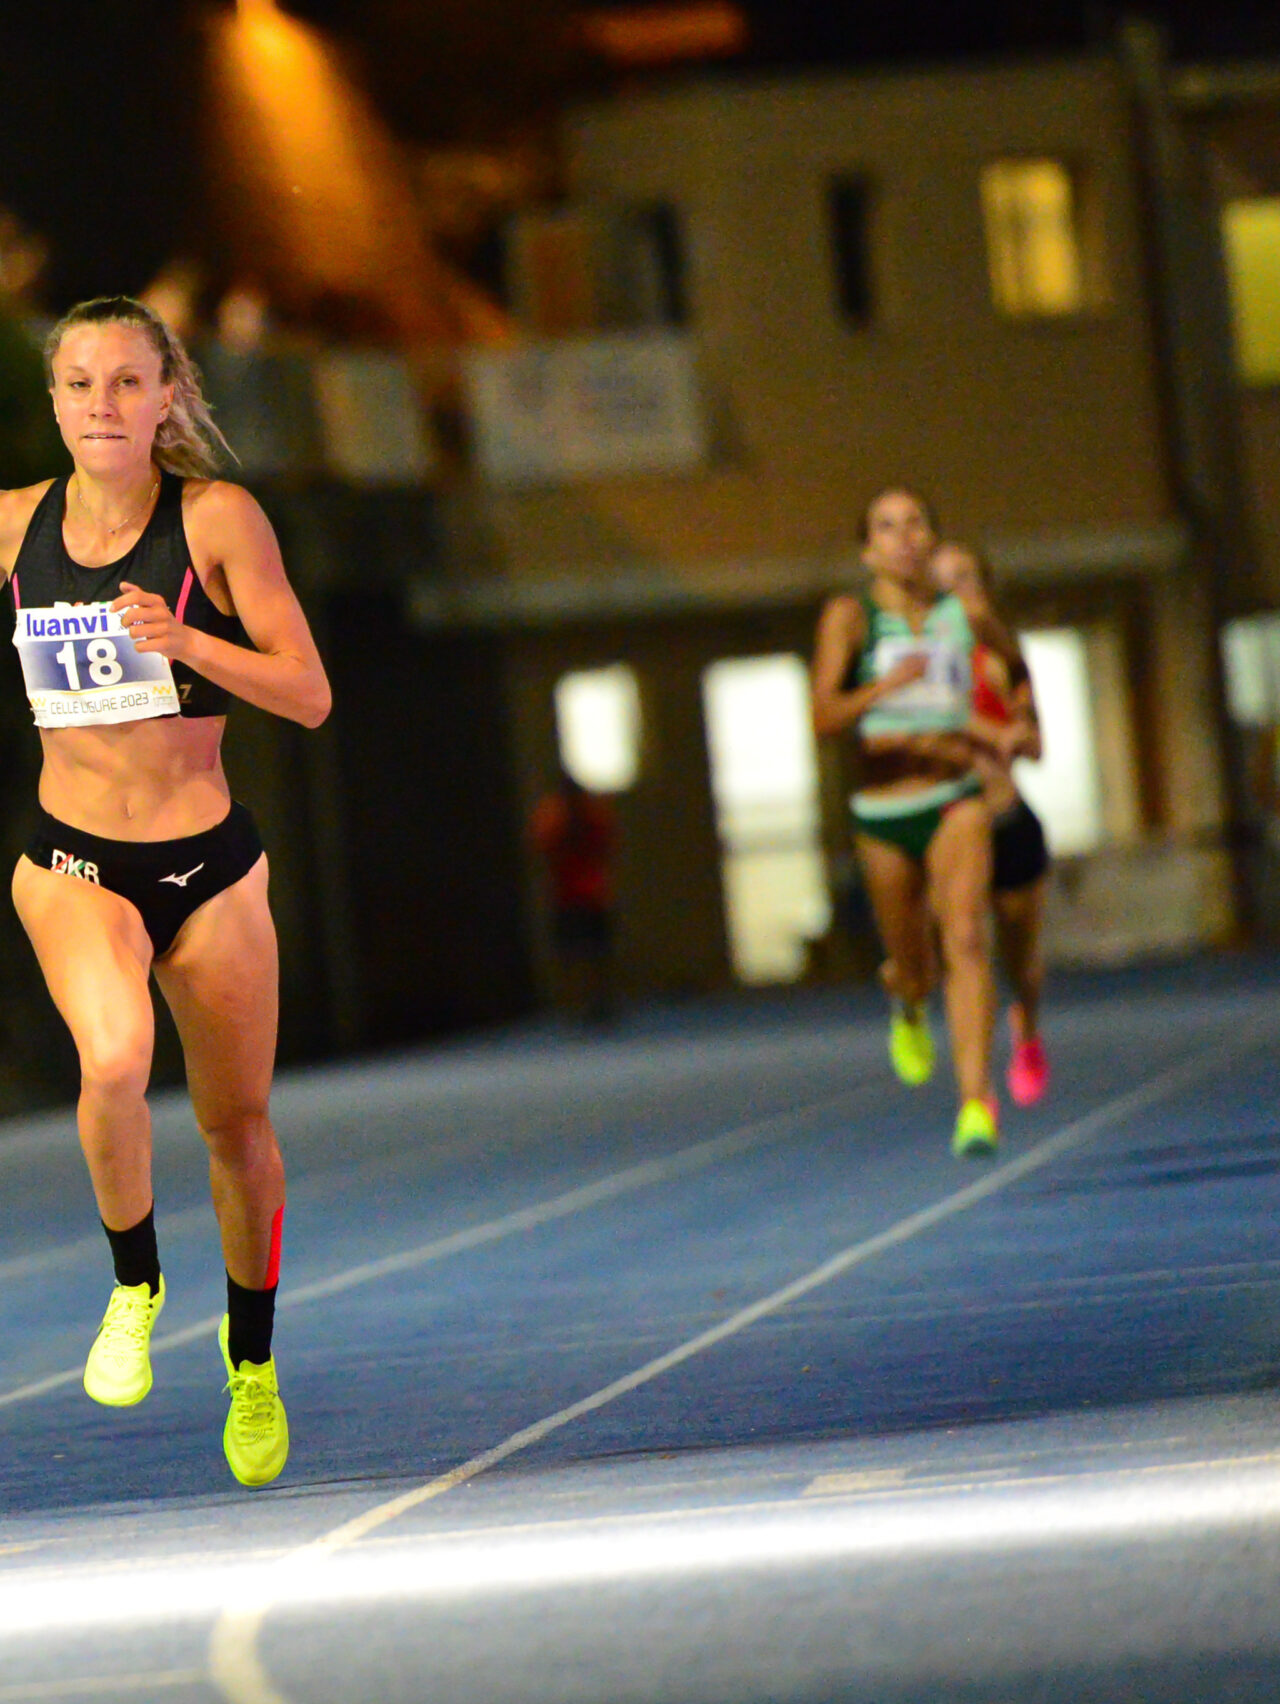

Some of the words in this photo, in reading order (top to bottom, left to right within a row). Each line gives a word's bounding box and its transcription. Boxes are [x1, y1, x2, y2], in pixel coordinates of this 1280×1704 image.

[26, 608, 109, 637] luanvi
[56, 638, 123, 691] 18
[50, 700, 80, 715] CELLE
[120, 692, 150, 709] 2023
